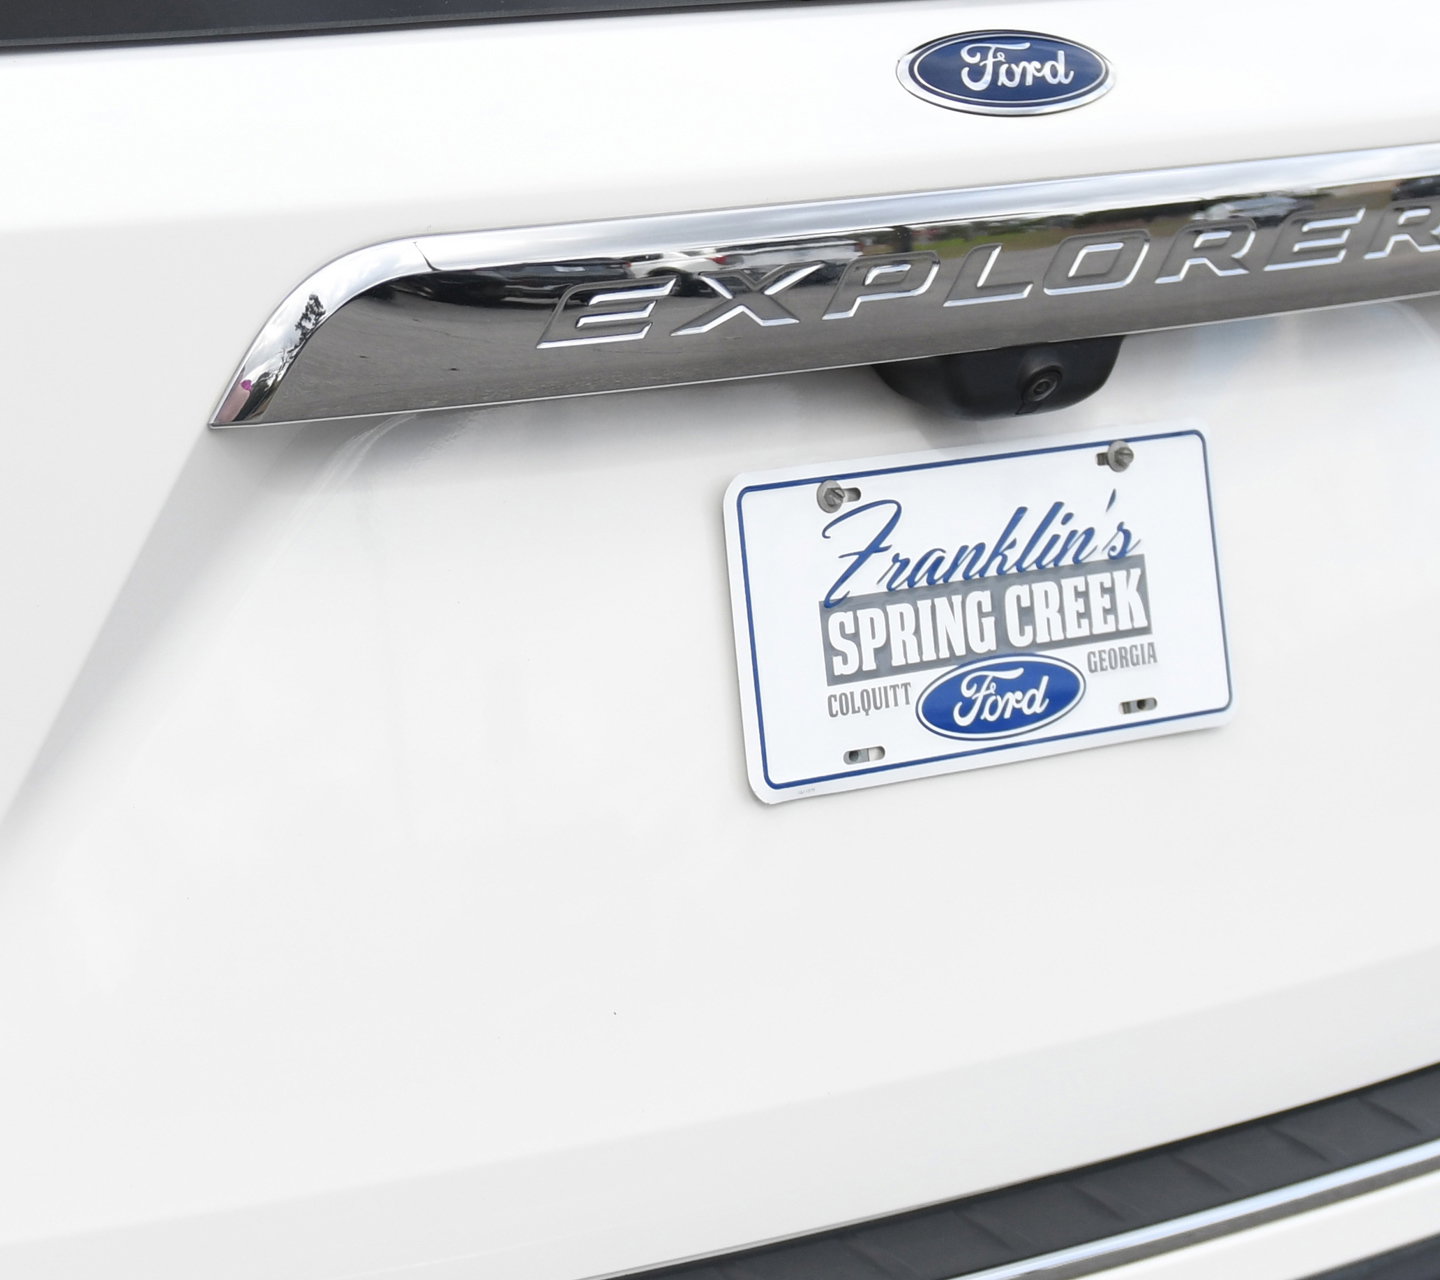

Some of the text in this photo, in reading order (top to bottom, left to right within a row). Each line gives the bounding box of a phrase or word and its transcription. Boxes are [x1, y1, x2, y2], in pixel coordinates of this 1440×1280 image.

[960, 42, 1075, 91] Ford
[821, 488, 1142, 609] Franklin's
[827, 568, 1149, 676] SPRING CREEK
[1086, 641, 1159, 675] GEORGIA
[826, 682, 913, 719] COLQUITT
[952, 666, 1050, 727] Ford
